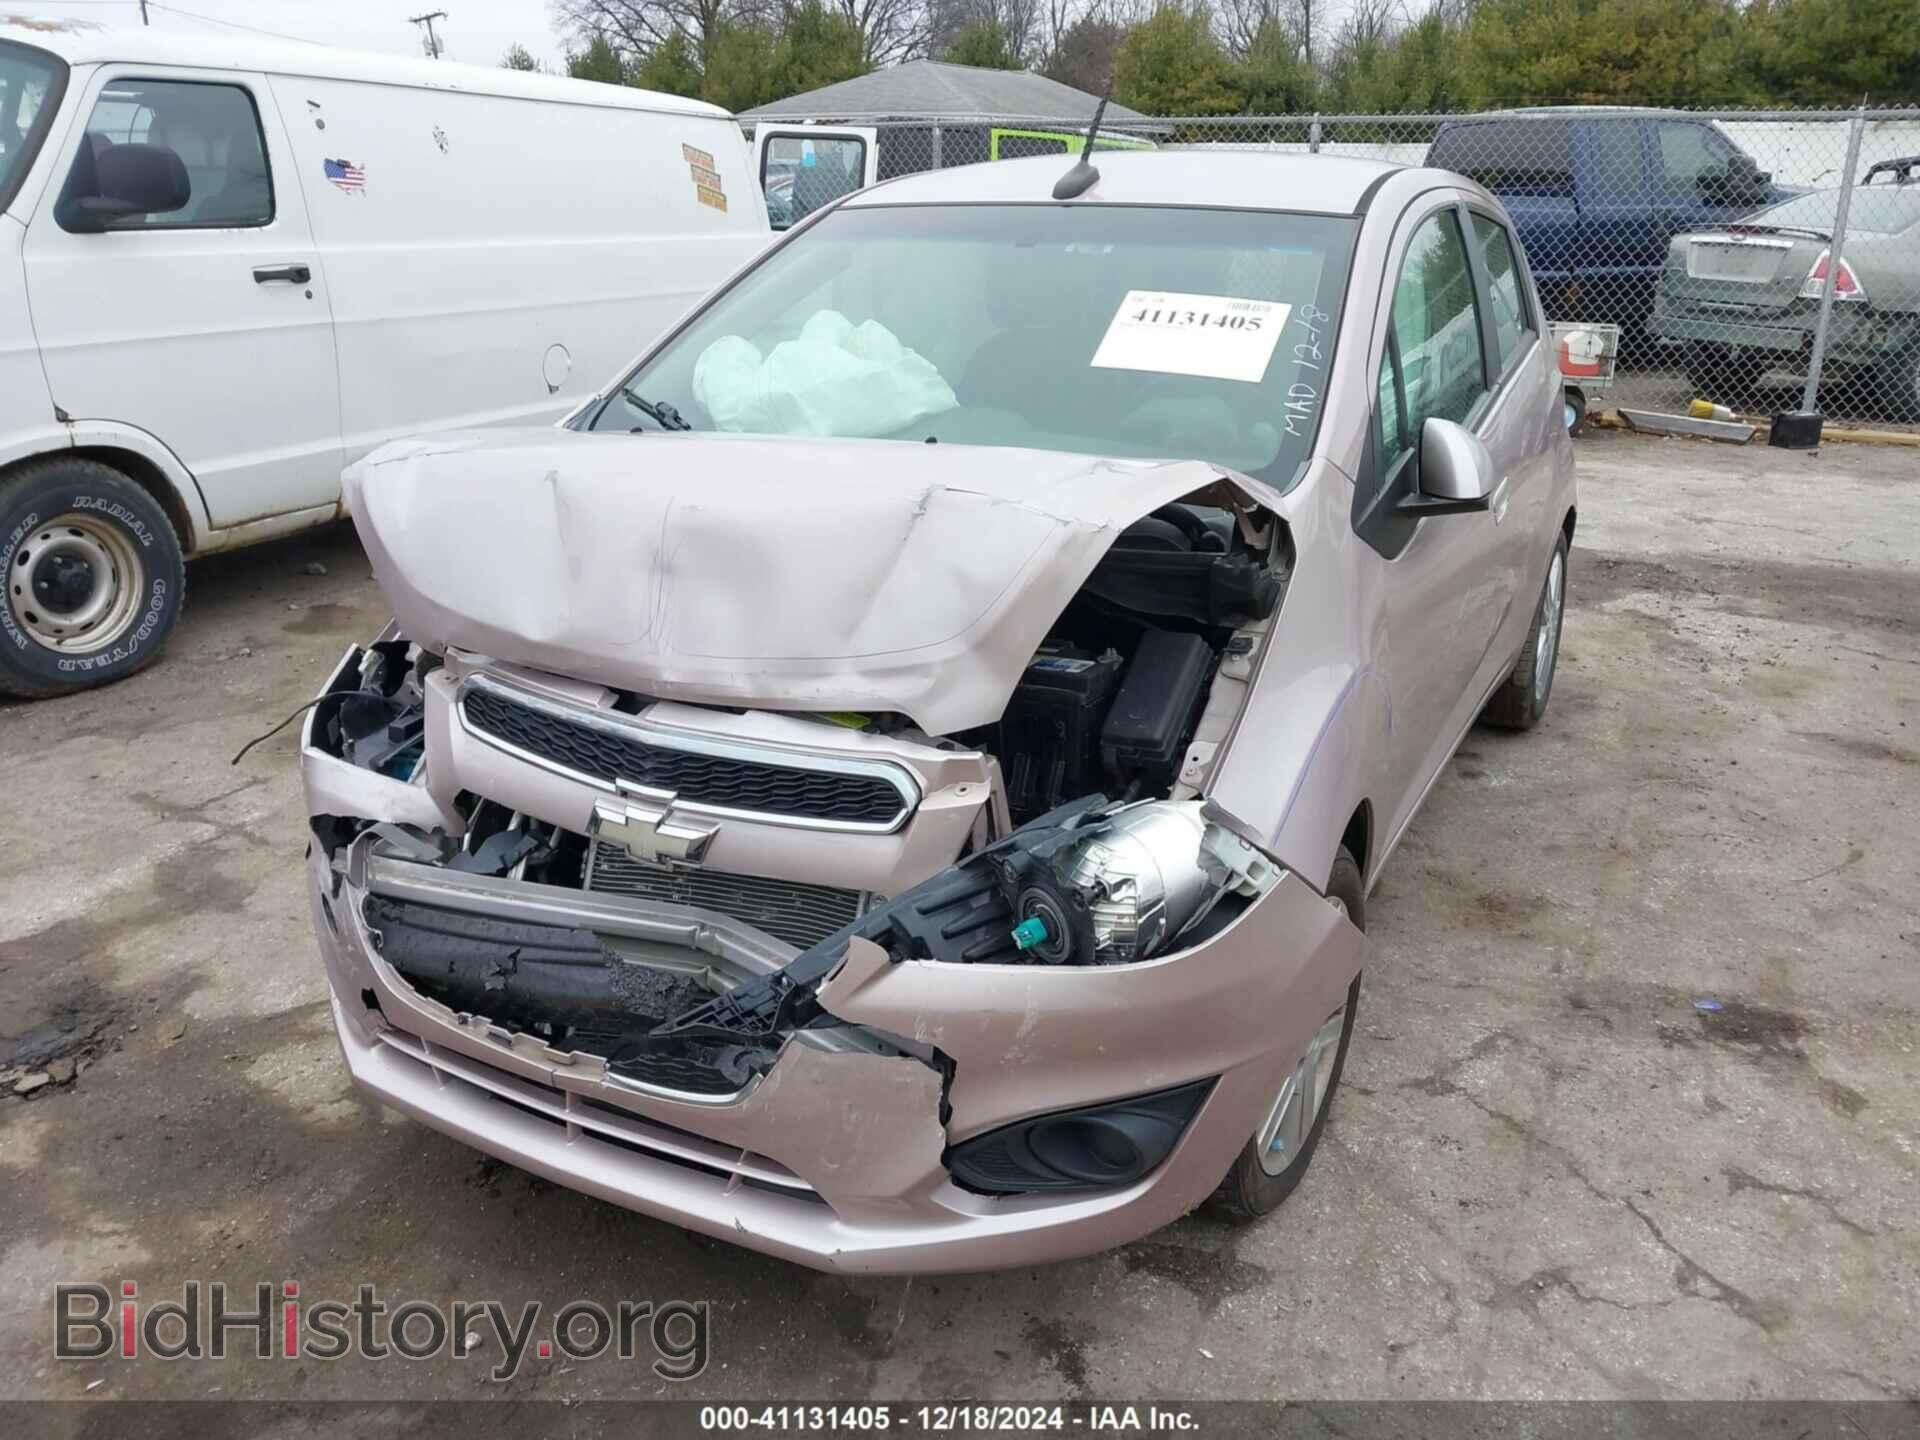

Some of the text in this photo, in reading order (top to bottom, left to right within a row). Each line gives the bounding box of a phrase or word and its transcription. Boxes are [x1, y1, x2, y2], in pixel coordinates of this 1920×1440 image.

[1132, 308, 1264, 332] 41131405
[1284, 304, 1329, 436] MAD 12-18
[72, 496, 154, 546] RADIAL
[58, 578, 165, 670] GOODYEAR
